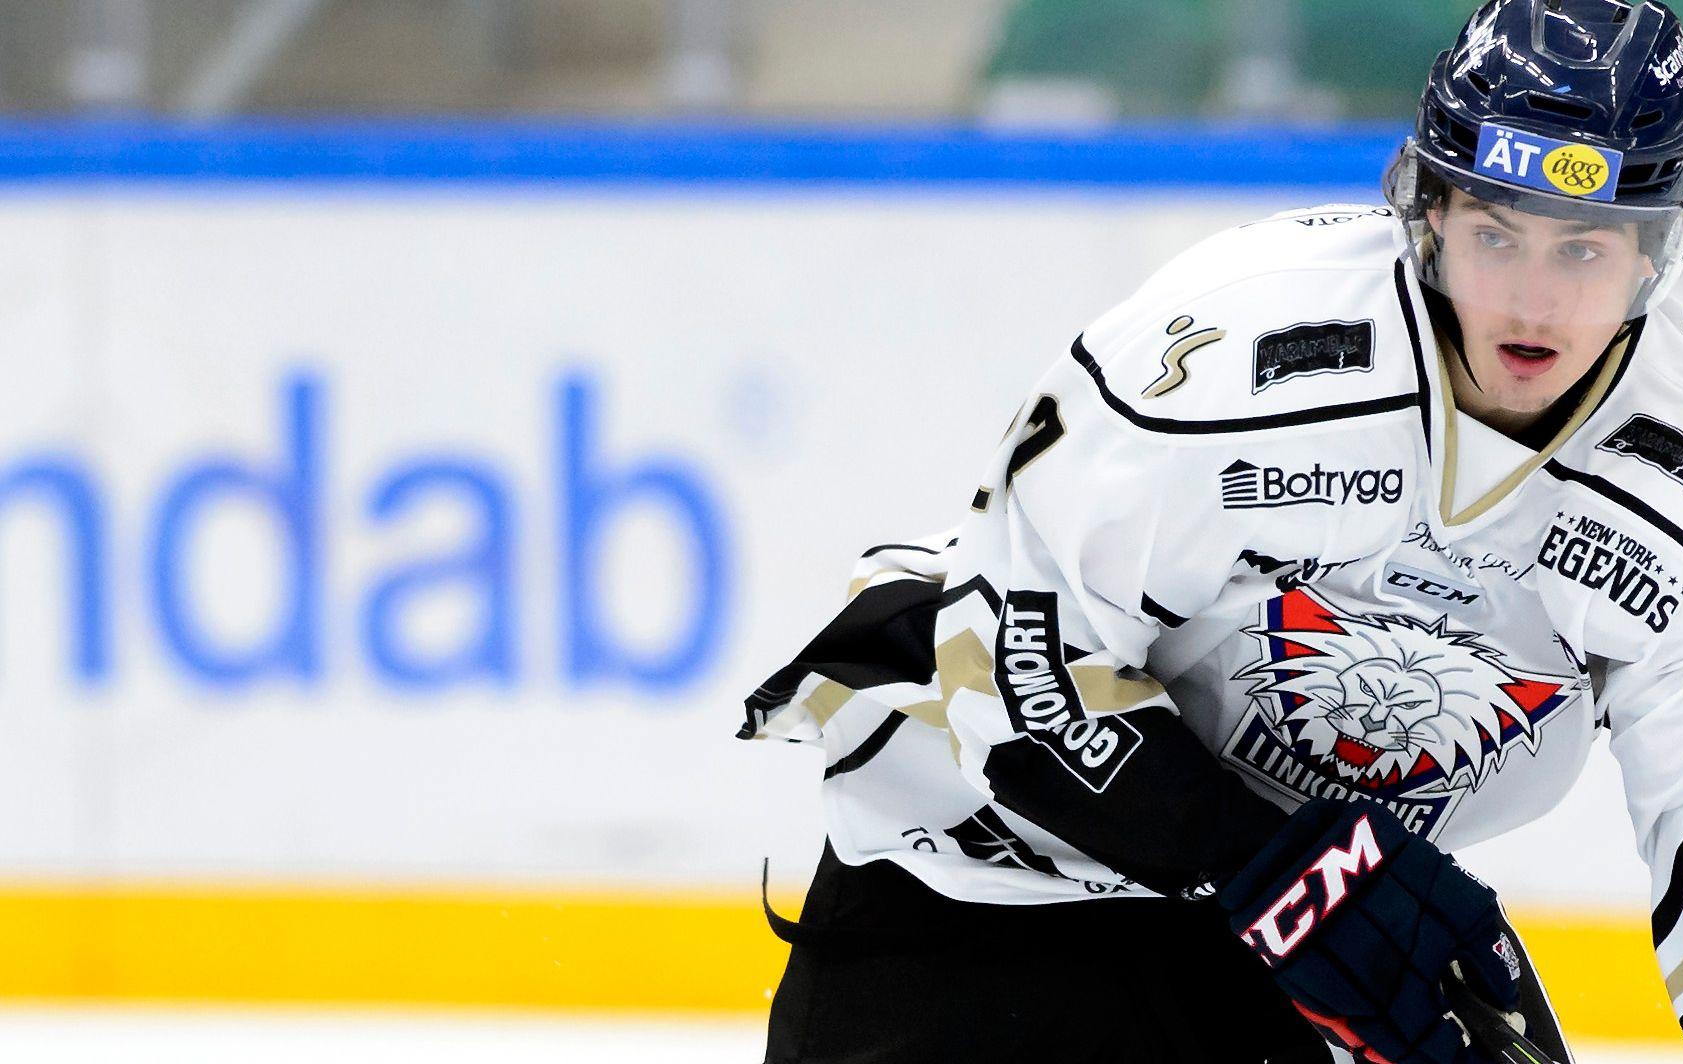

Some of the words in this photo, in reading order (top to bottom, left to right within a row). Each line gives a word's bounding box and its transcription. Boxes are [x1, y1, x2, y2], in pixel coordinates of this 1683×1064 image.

[1482, 130, 1541, 177] ÄT
[1551, 151, 1604, 190] ägg
[1263, 463, 1403, 505] Botrygg
[1574, 515, 1617, 546] NEW
[1615, 533, 1658, 571] YORK
[1387, 570, 1479, 606] CCM
[1537, 524, 1680, 634] EGENDS
[1241, 814, 1383, 968] CM
